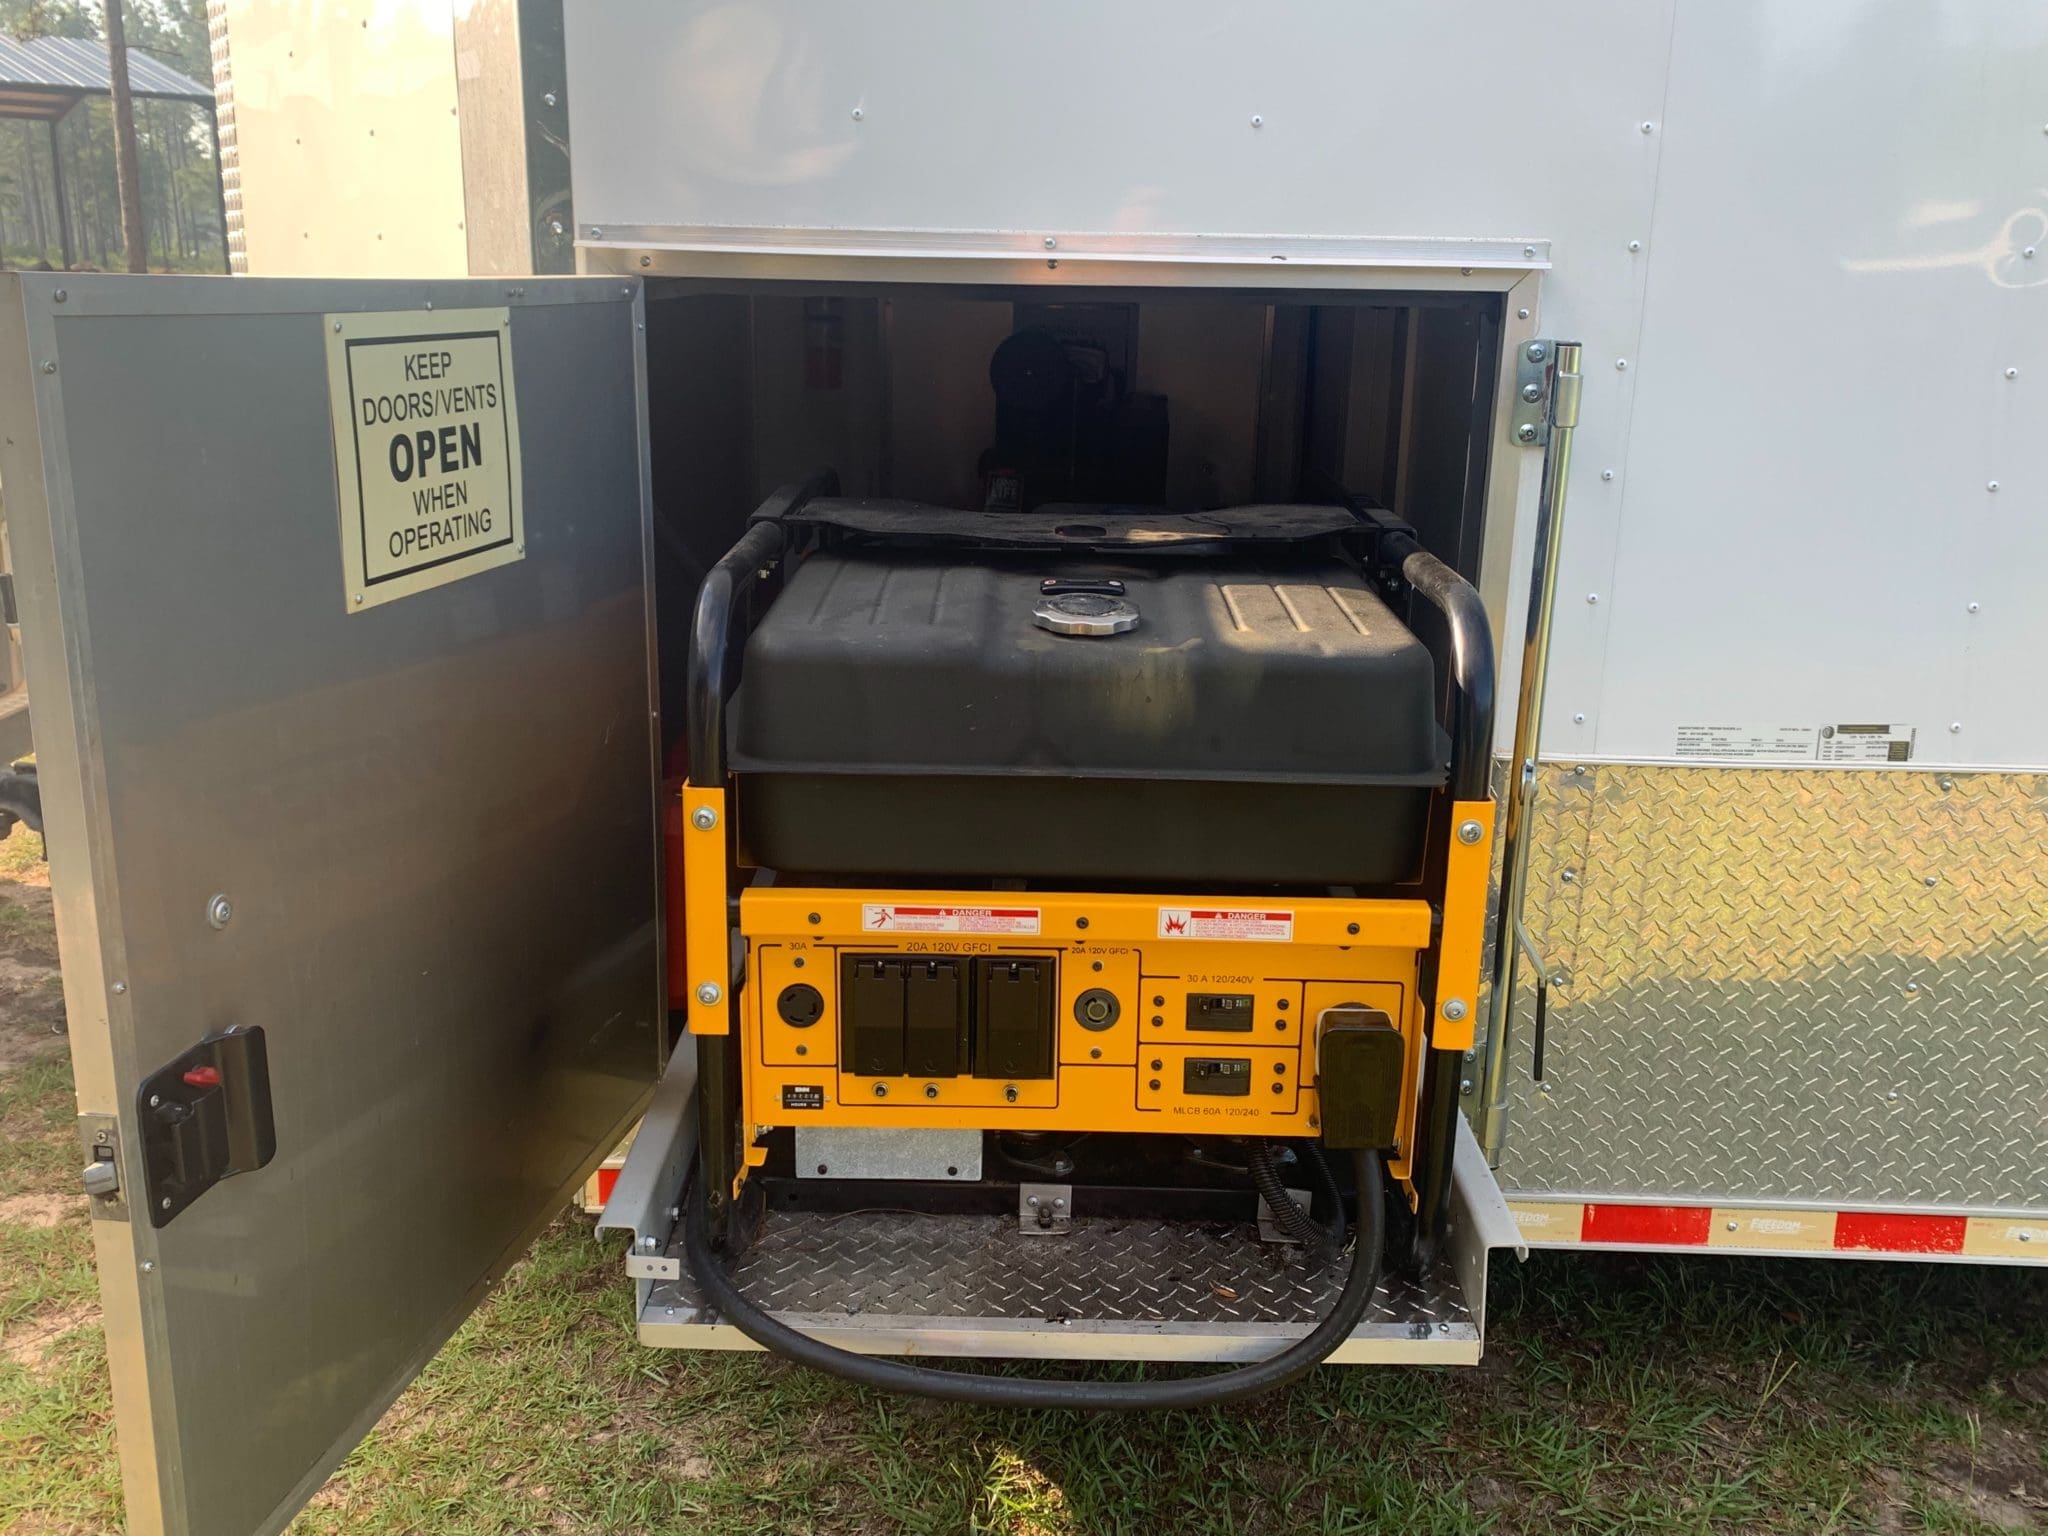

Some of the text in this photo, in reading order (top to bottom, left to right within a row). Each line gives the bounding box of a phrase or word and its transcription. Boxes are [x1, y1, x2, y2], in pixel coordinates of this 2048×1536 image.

[404, 351, 452, 382] KEEP
[363, 383, 497, 426] DOORS/VENTS
[389, 422, 482, 483] OPEN
[413, 480, 468, 516] WHEN
[389, 508, 492, 558] OPERATING
[952, 909, 992, 917] DANGER
[1228, 912, 1266, 920] DANGER
[789, 942, 807, 951] 30A
[906, 942, 991, 953] 20A 120V GFCI
[1071, 946, 1086, 954] 20A
[1108, 947, 1129, 955] GFCI
[1187, 974, 1254, 984] 30 A 120/240V
[1173, 1106, 1260, 1117] MLCB 60A 120/240
[1751, 1217, 1802, 1230] FREEDOM
